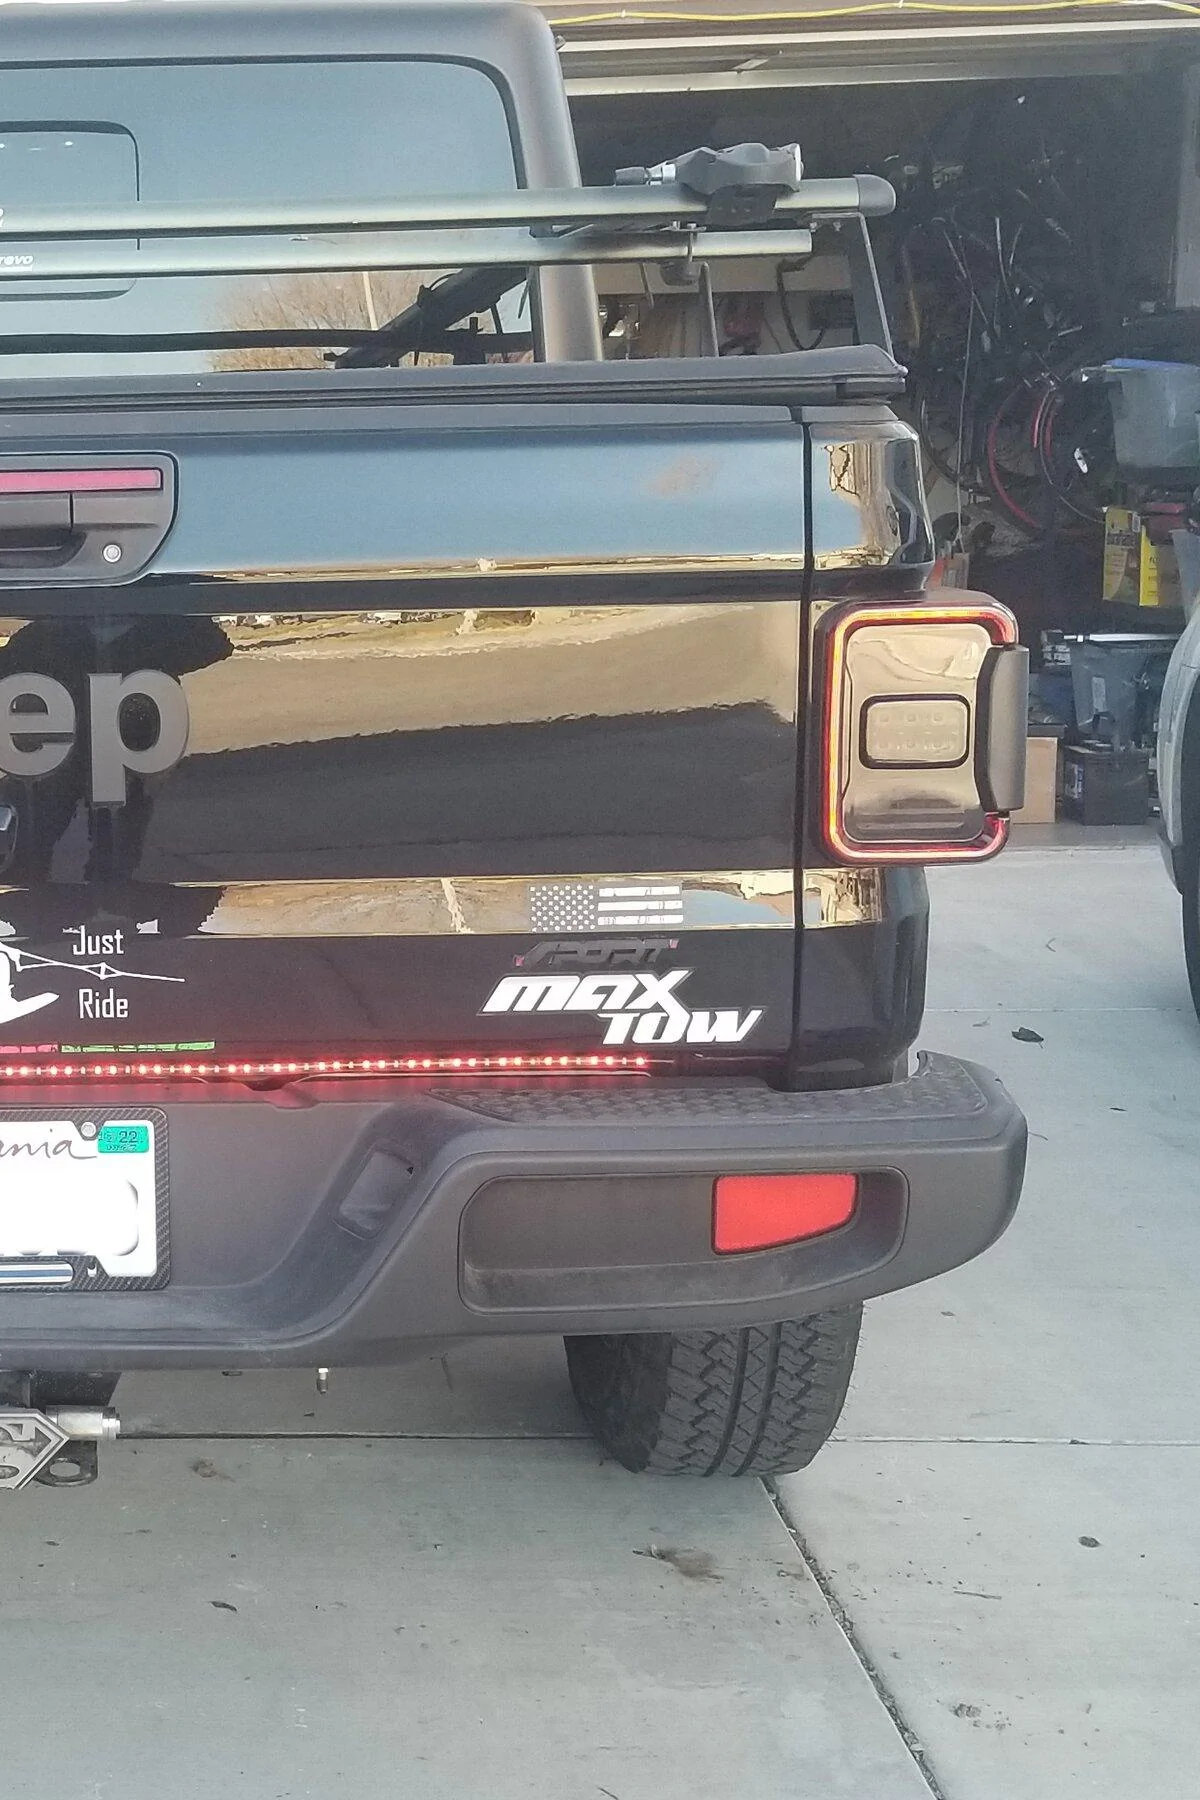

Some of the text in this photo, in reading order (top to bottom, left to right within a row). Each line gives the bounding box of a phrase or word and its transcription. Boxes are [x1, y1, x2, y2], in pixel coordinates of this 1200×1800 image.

[72, 925, 125, 955] Just
[78, 988, 128, 1019] Ride
[118, 1130, 138, 1143] 22
